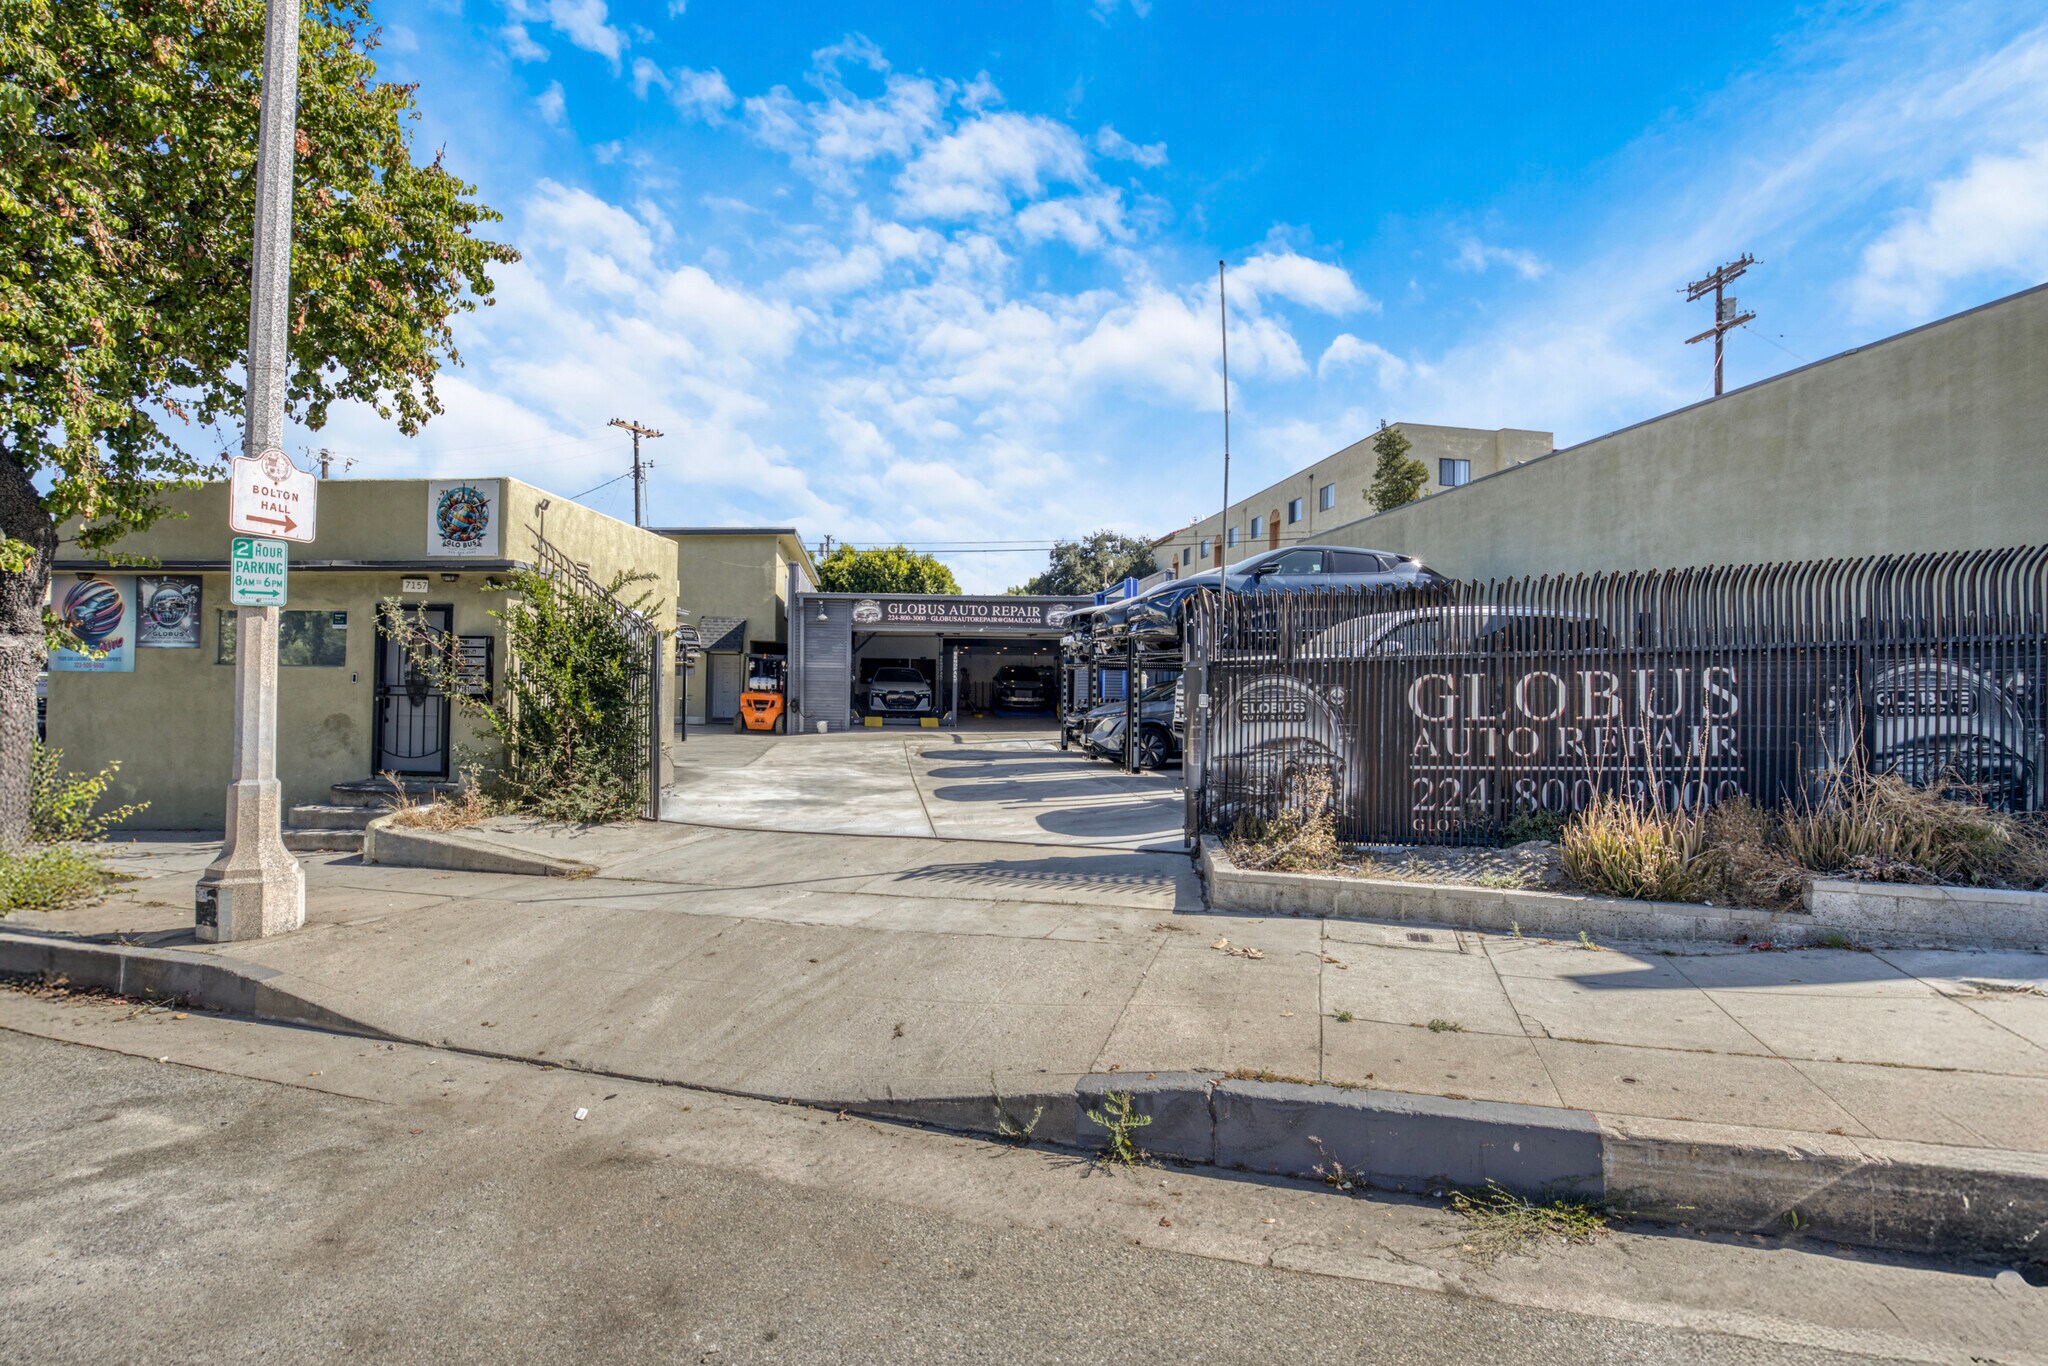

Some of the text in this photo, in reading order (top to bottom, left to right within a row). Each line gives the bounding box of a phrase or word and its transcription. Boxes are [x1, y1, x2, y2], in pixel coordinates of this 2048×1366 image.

[252, 485, 299, 502] BOLTON
[261, 501, 290, 514] HALL
[236, 541, 283, 558] 2 HOUR
[236, 560, 283, 575] PARKING
[405, 580, 428, 590] 7157
[887, 603, 945, 615] GLOBUS
[949, 604, 988, 616] AUTO
[992, 605, 1041, 617] REPAIR
[930, 615, 1041, 624] GLOBUSAUTOREPAIR@GMAIL.COM
[98, 637, 124, 652] AUTO
[1407, 666, 1740, 723] GLOBUS
[1409, 725, 1743, 758] AUTO REPAIR
[1412, 777, 1744, 813] 224-8003000
